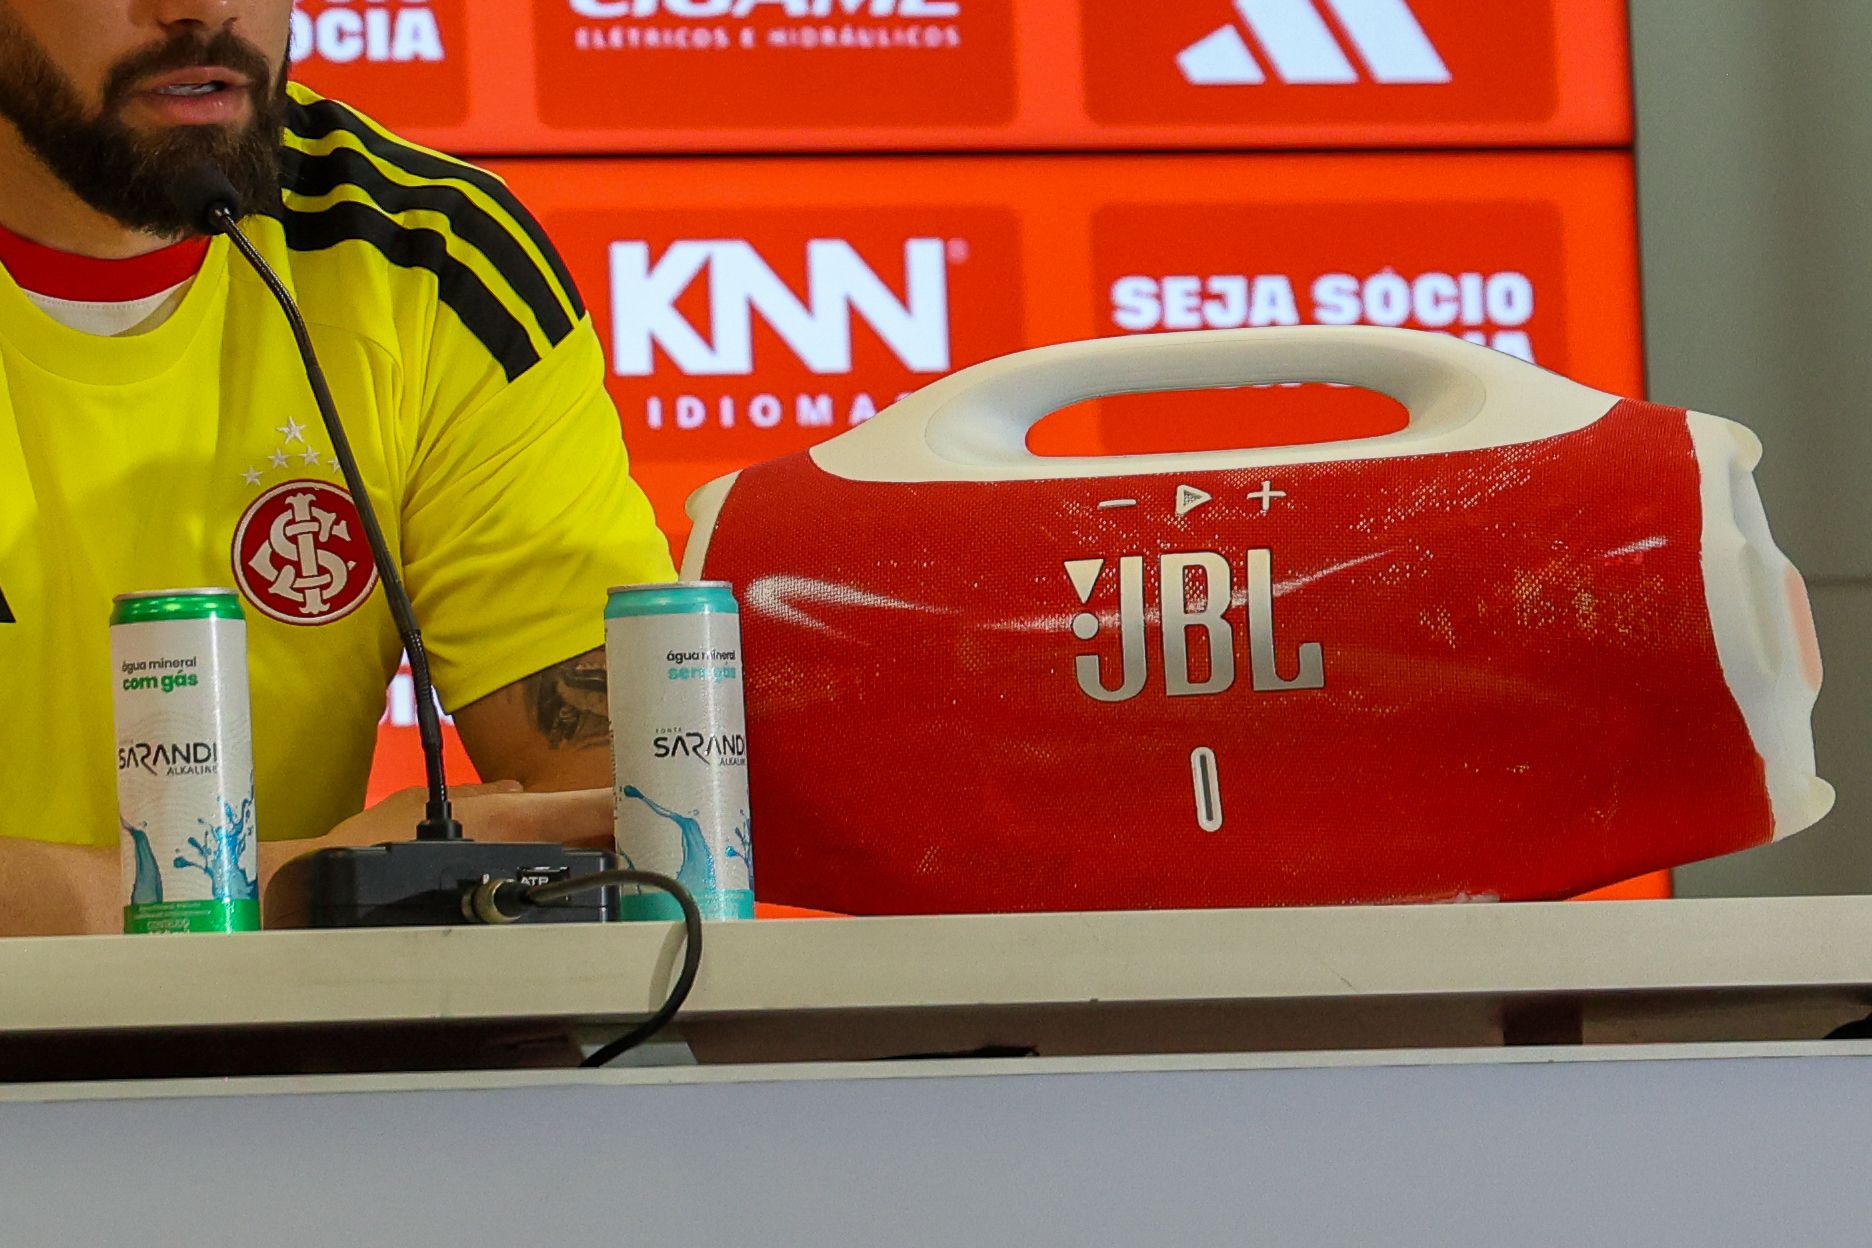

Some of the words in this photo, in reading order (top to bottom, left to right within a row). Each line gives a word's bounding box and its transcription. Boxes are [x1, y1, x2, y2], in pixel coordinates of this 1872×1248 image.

[290, 6, 444, 63] CIA
[608, 238, 950, 376] KNN
[1111, 275, 1299, 330] SEJA
[1312, 266, 1534, 326] SÓCIO
[646, 391, 914, 430] IDIOMA
[1073, 549, 1324, 702] JBL
[149, 656, 196, 669] mineral
[666, 650, 699, 664] água
[123, 675, 158, 690] com
[161, 669, 198, 692] gás
[119, 742, 218, 776] SARANDI
[521, 876, 549, 885] ATP
